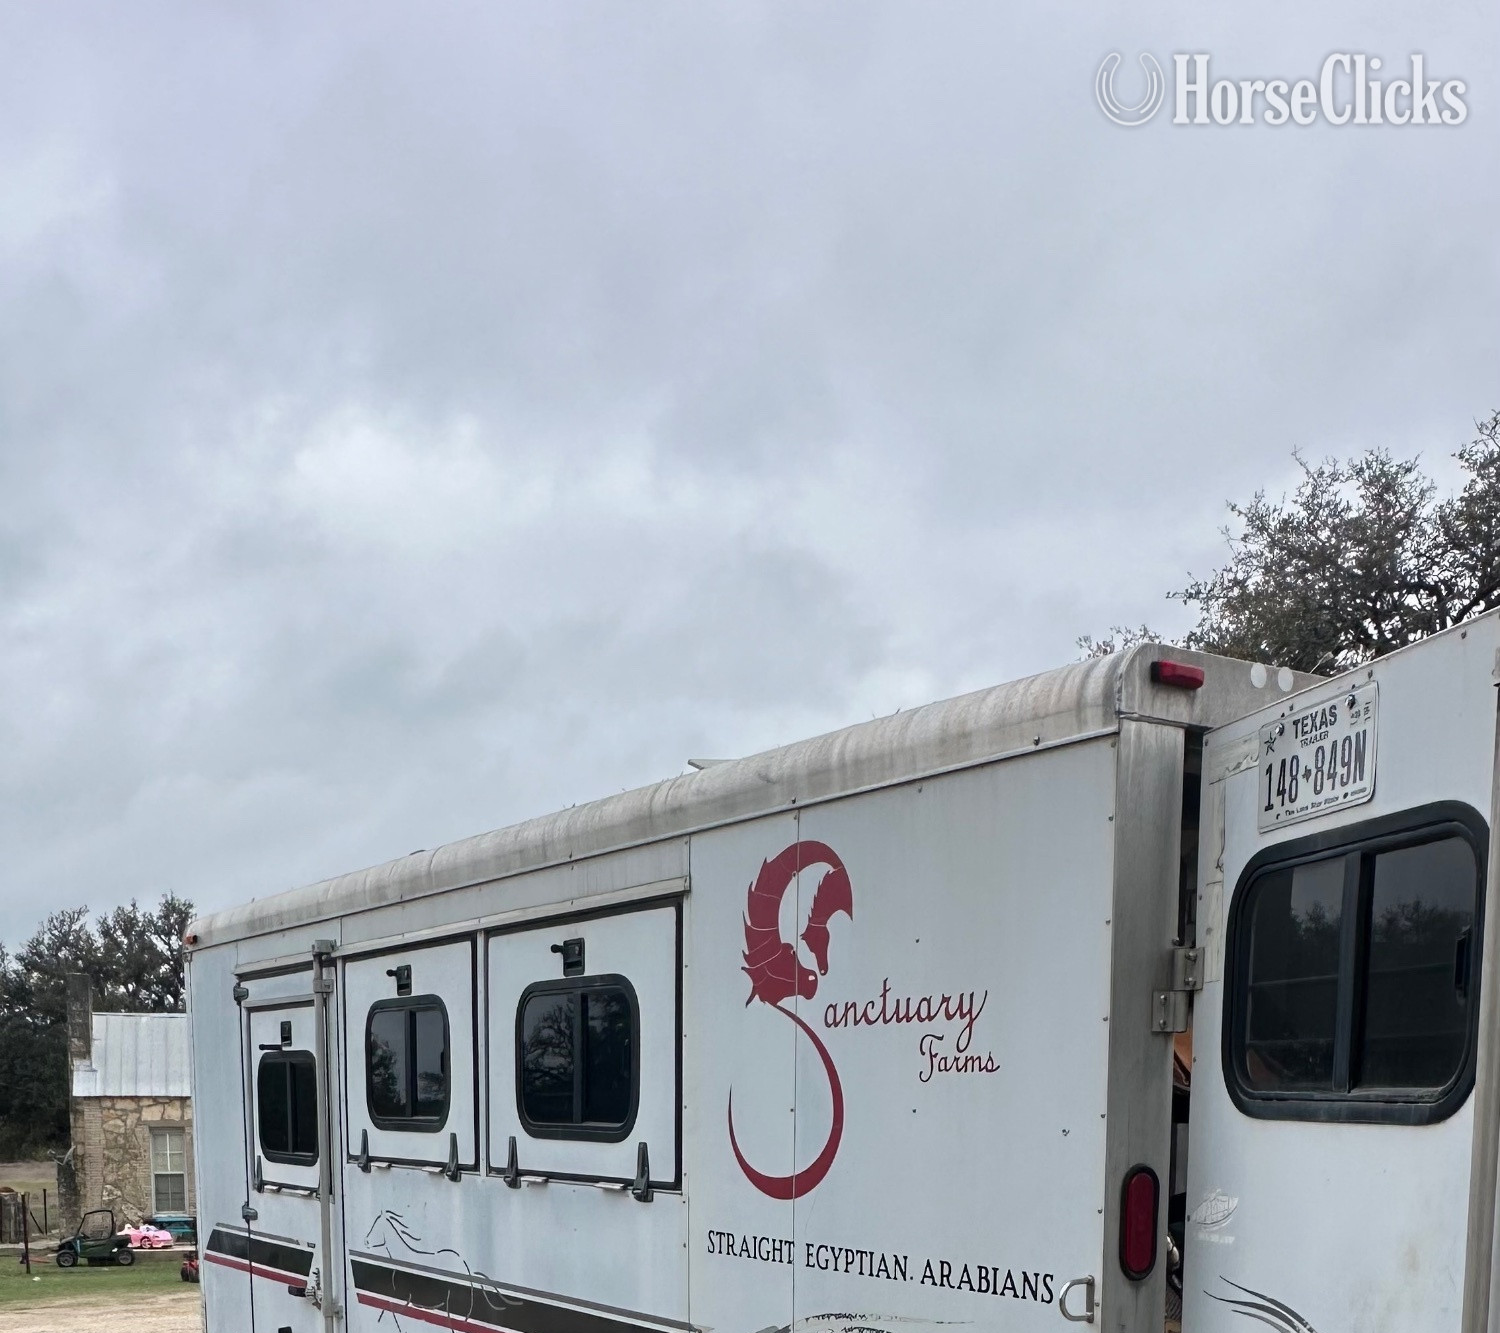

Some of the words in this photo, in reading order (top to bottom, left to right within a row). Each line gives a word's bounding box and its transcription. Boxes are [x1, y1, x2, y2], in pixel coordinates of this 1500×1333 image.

[1292, 704, 1338, 739] TEXAS
[1300, 730, 1329, 749] TRAILER
[918, 1033, 1001, 1084] Farms
[707, 1230, 795, 1265] STRAIGHT
[920, 1258, 1055, 1305] ARABIANS
